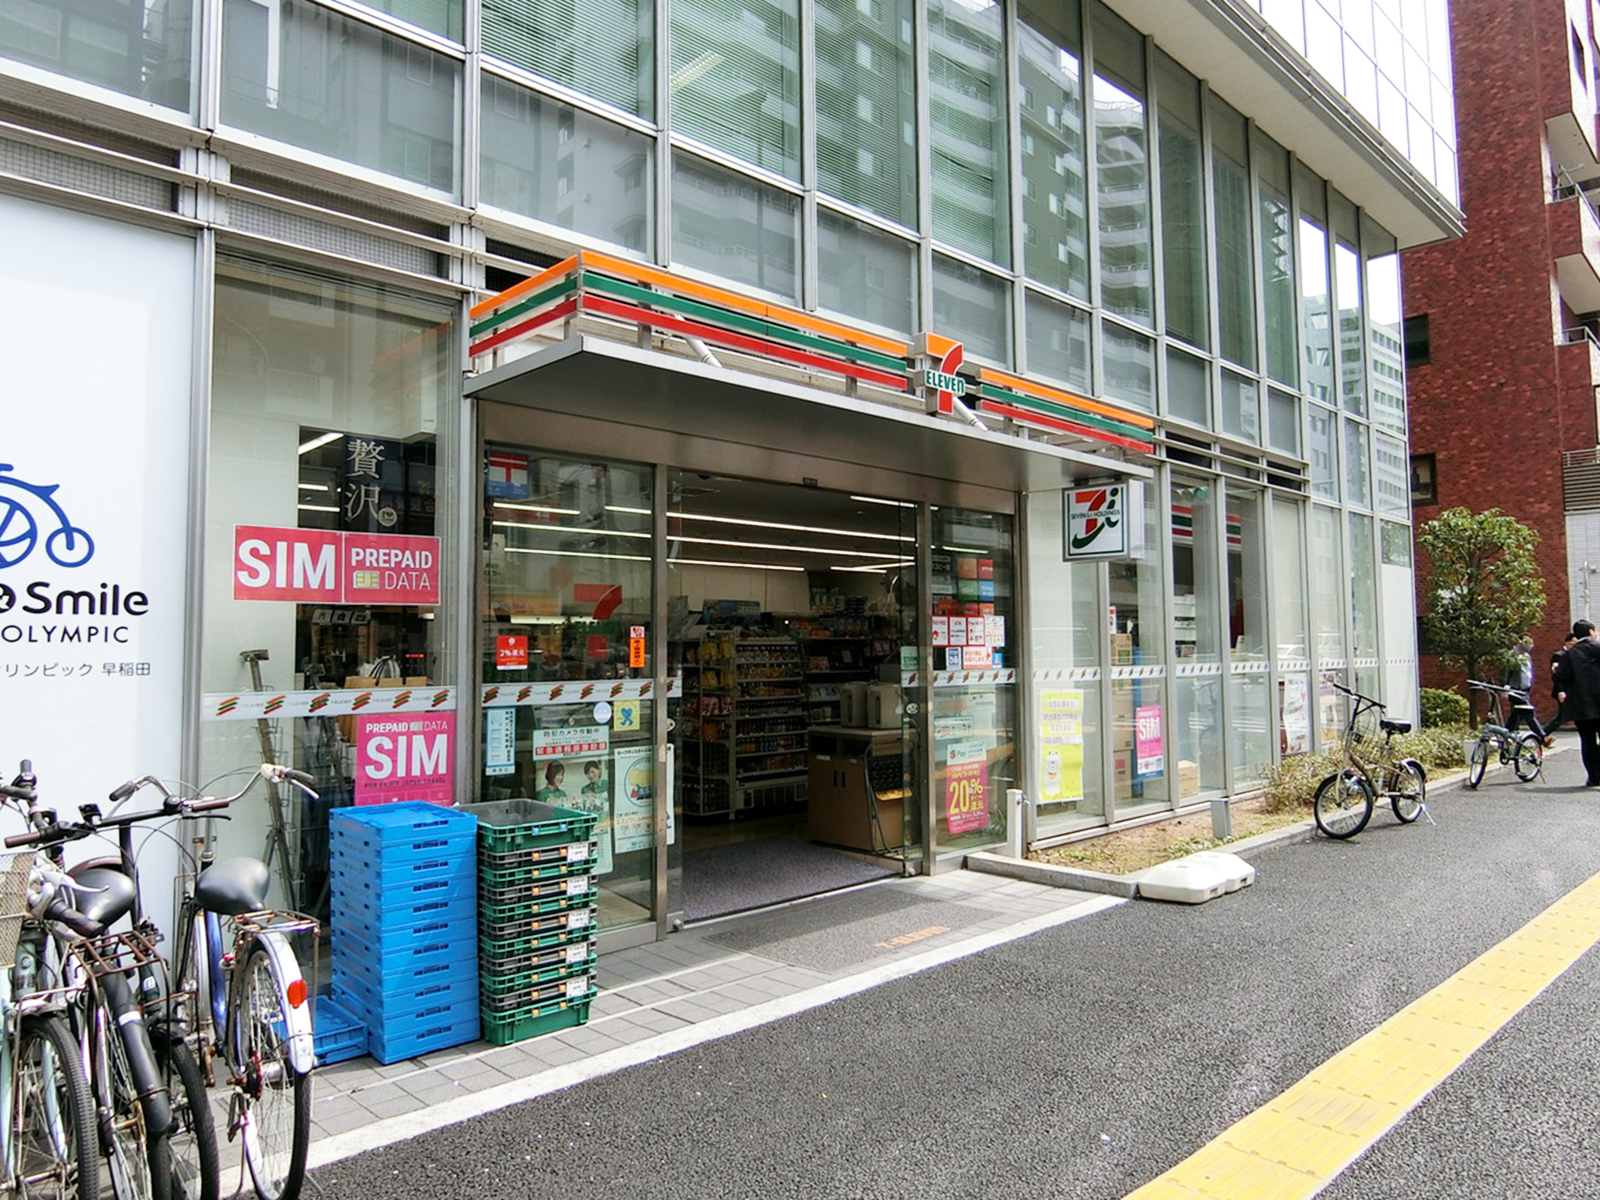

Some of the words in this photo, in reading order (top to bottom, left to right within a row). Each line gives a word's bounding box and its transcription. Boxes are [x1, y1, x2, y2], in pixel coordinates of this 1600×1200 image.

[345, 438, 386, 522] 贅沢
[236, 538, 336, 590] SIM
[350, 547, 433, 569] PREPAID
[384, 570, 431, 590] DATA
[22, 580, 149, 616] Smile
[1, 624, 129, 644] OLYMPIC
[0, 662, 93, 678] リンピック
[101, 662, 151, 677] 早稲田
[365, 722, 409, 734] PREPAID
[423, 720, 448, 732] DATA
[543, 728, 600, 738] 防犯カメラ作動中
[1138, 716, 1161, 741] SIM
[364, 733, 448, 780] SIM
[949, 777, 984, 815] 20%
